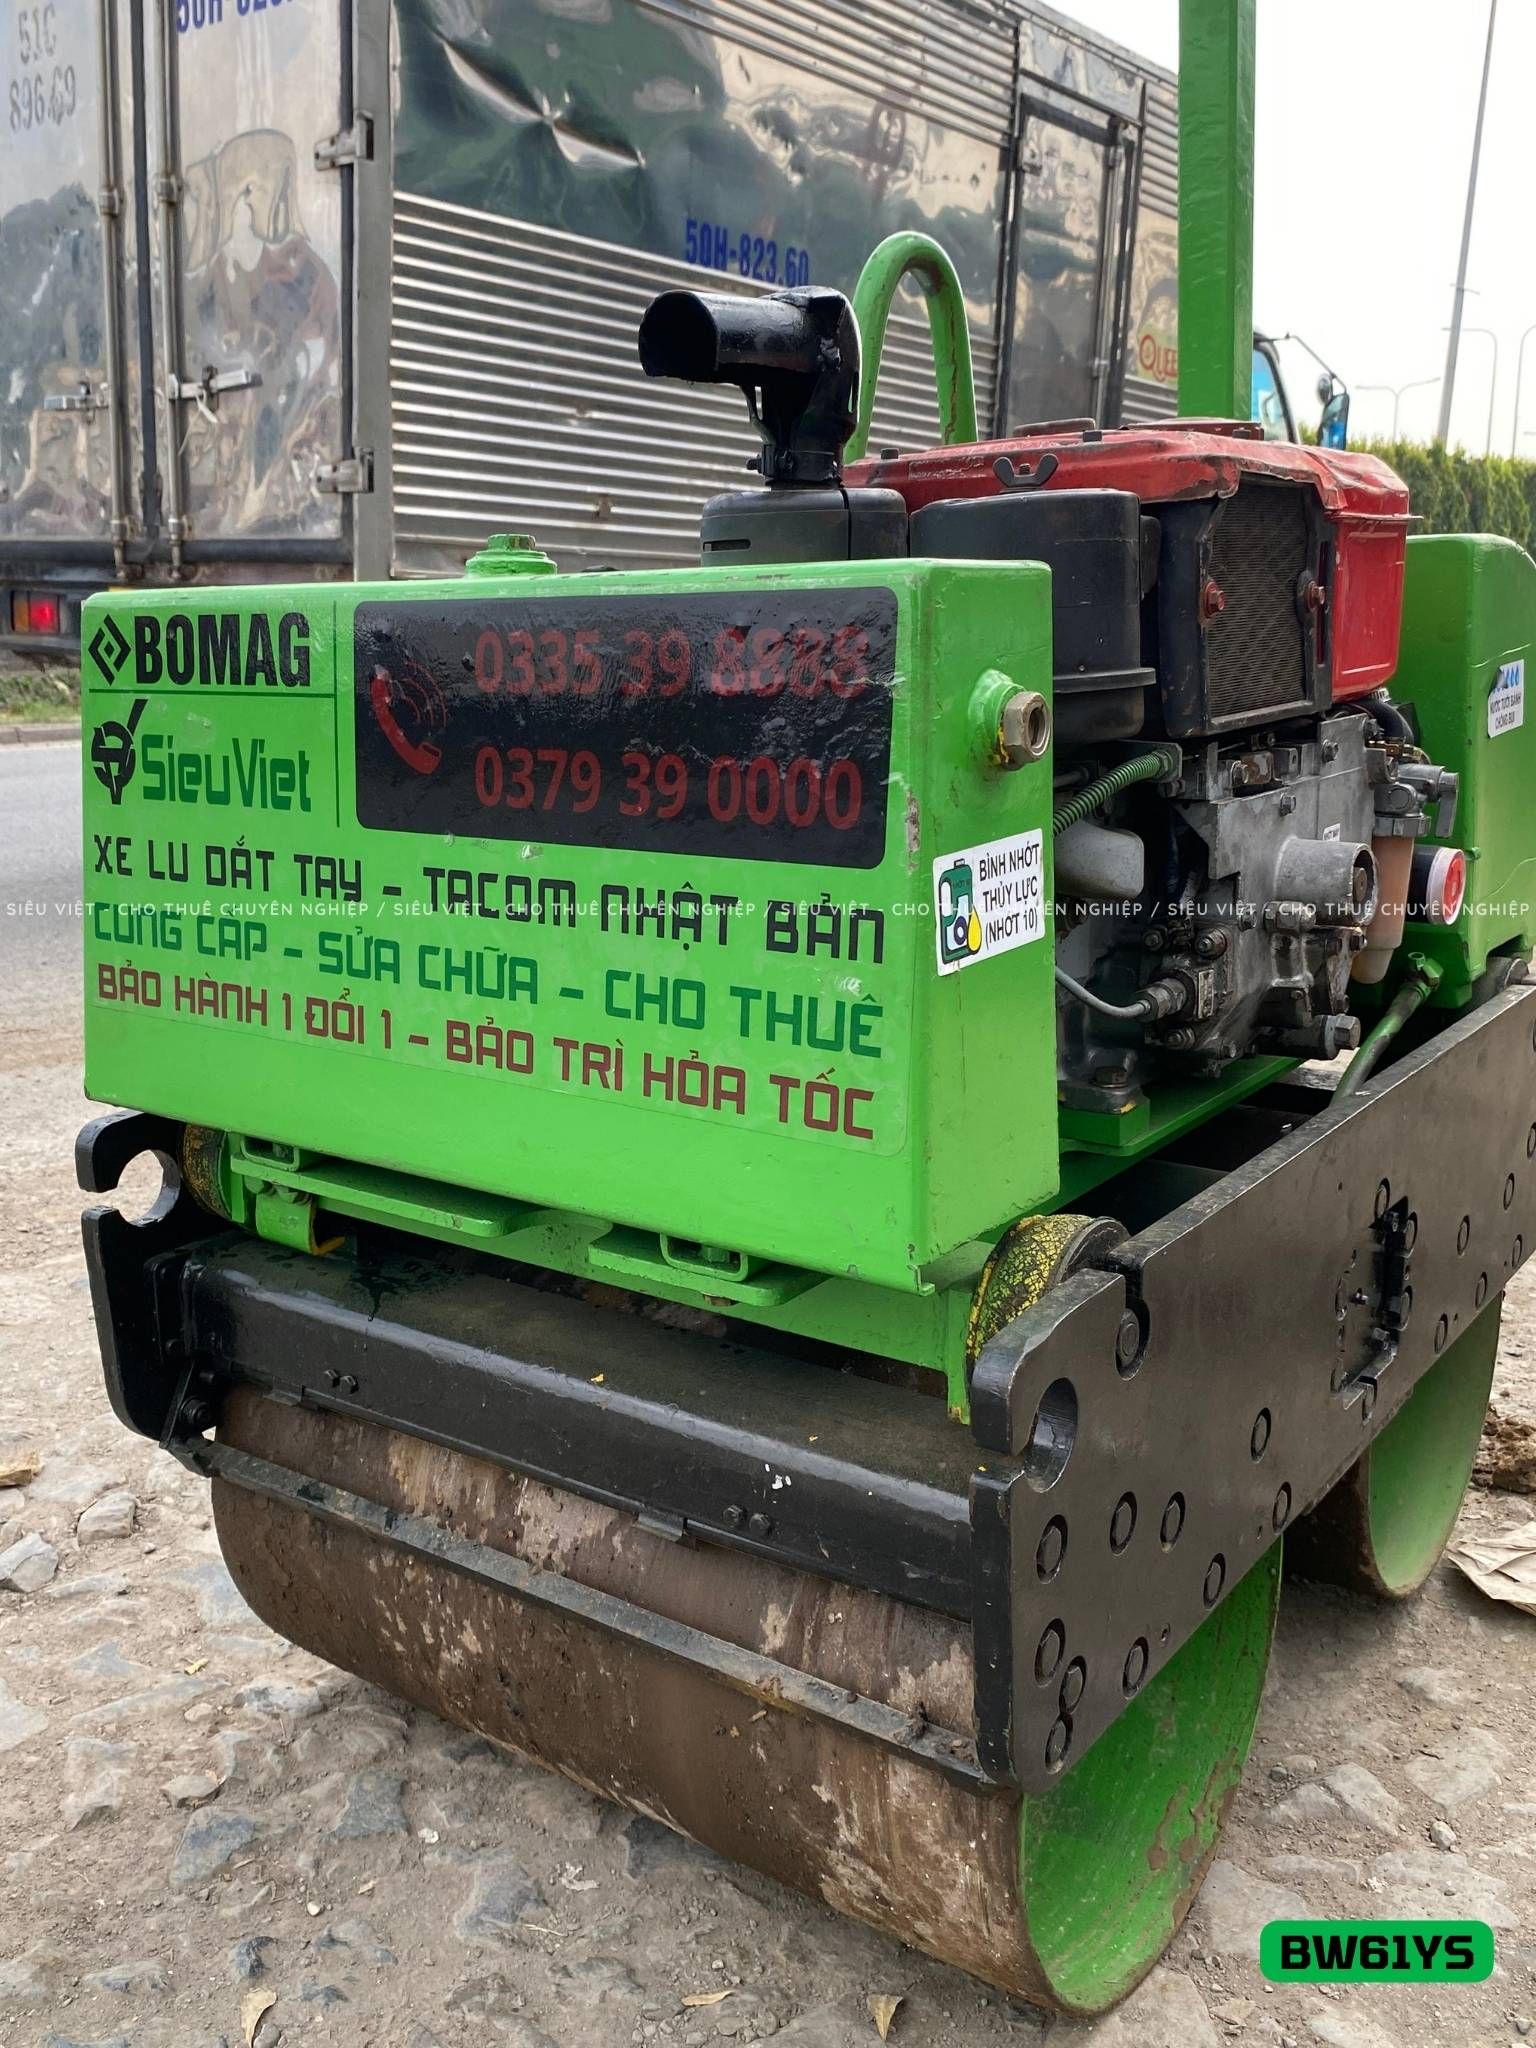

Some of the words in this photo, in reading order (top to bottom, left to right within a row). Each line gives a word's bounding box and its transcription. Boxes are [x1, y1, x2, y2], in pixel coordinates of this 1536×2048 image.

[685, 218, 810, 288] 50H-823.60
[133, 611, 311, 688] BOMAG
[473, 627, 602, 695] 0335
[622, 627, 692, 697] 39
[710, 625, 872, 699] 8888
[141, 734, 312, 813] SieuViet
[474, 746, 601, 813] 0379
[619, 752, 689, 818] 39
[706, 754, 863, 830] 0000
[93, 834, 133, 876] XE
[147, 839, 189, 883] LU
[205, 834, 275, 892] DẮT
[293, 853, 363, 903] TAY
[422, 866, 577, 929] TACOM
[600, 880, 739, 951] NHẬT
[765, 892, 885, 964] BẢN
[979, 852, 1006, 881] BÌNH
[1009, 840, 1040, 873] NHỚT
[982, 880, 1012, 913] THỦY
[1016, 875, 1038, 905] LỰC
[318, 926, 401, 984] SỬA
[418, 945, 538, 1005] CHỮA
[605, 968, 706, 1030] CHO
[729, 984, 884, 1059] THUÊ
[98, 959, 162, 1008] BẢO
[174, 971, 268, 1027] HÀNH
[281, 992, 292, 1031] 1
[304, 987, 365, 1045] ĐỔI
[380, 1008, 392, 1049] 1
[445, 1015, 534, 1075] BẢO
[553, 1036, 624, 1092] TRÌ
[642, 1049, 746, 1115] HỎA
[768, 1066, 875, 1140] TỐC
